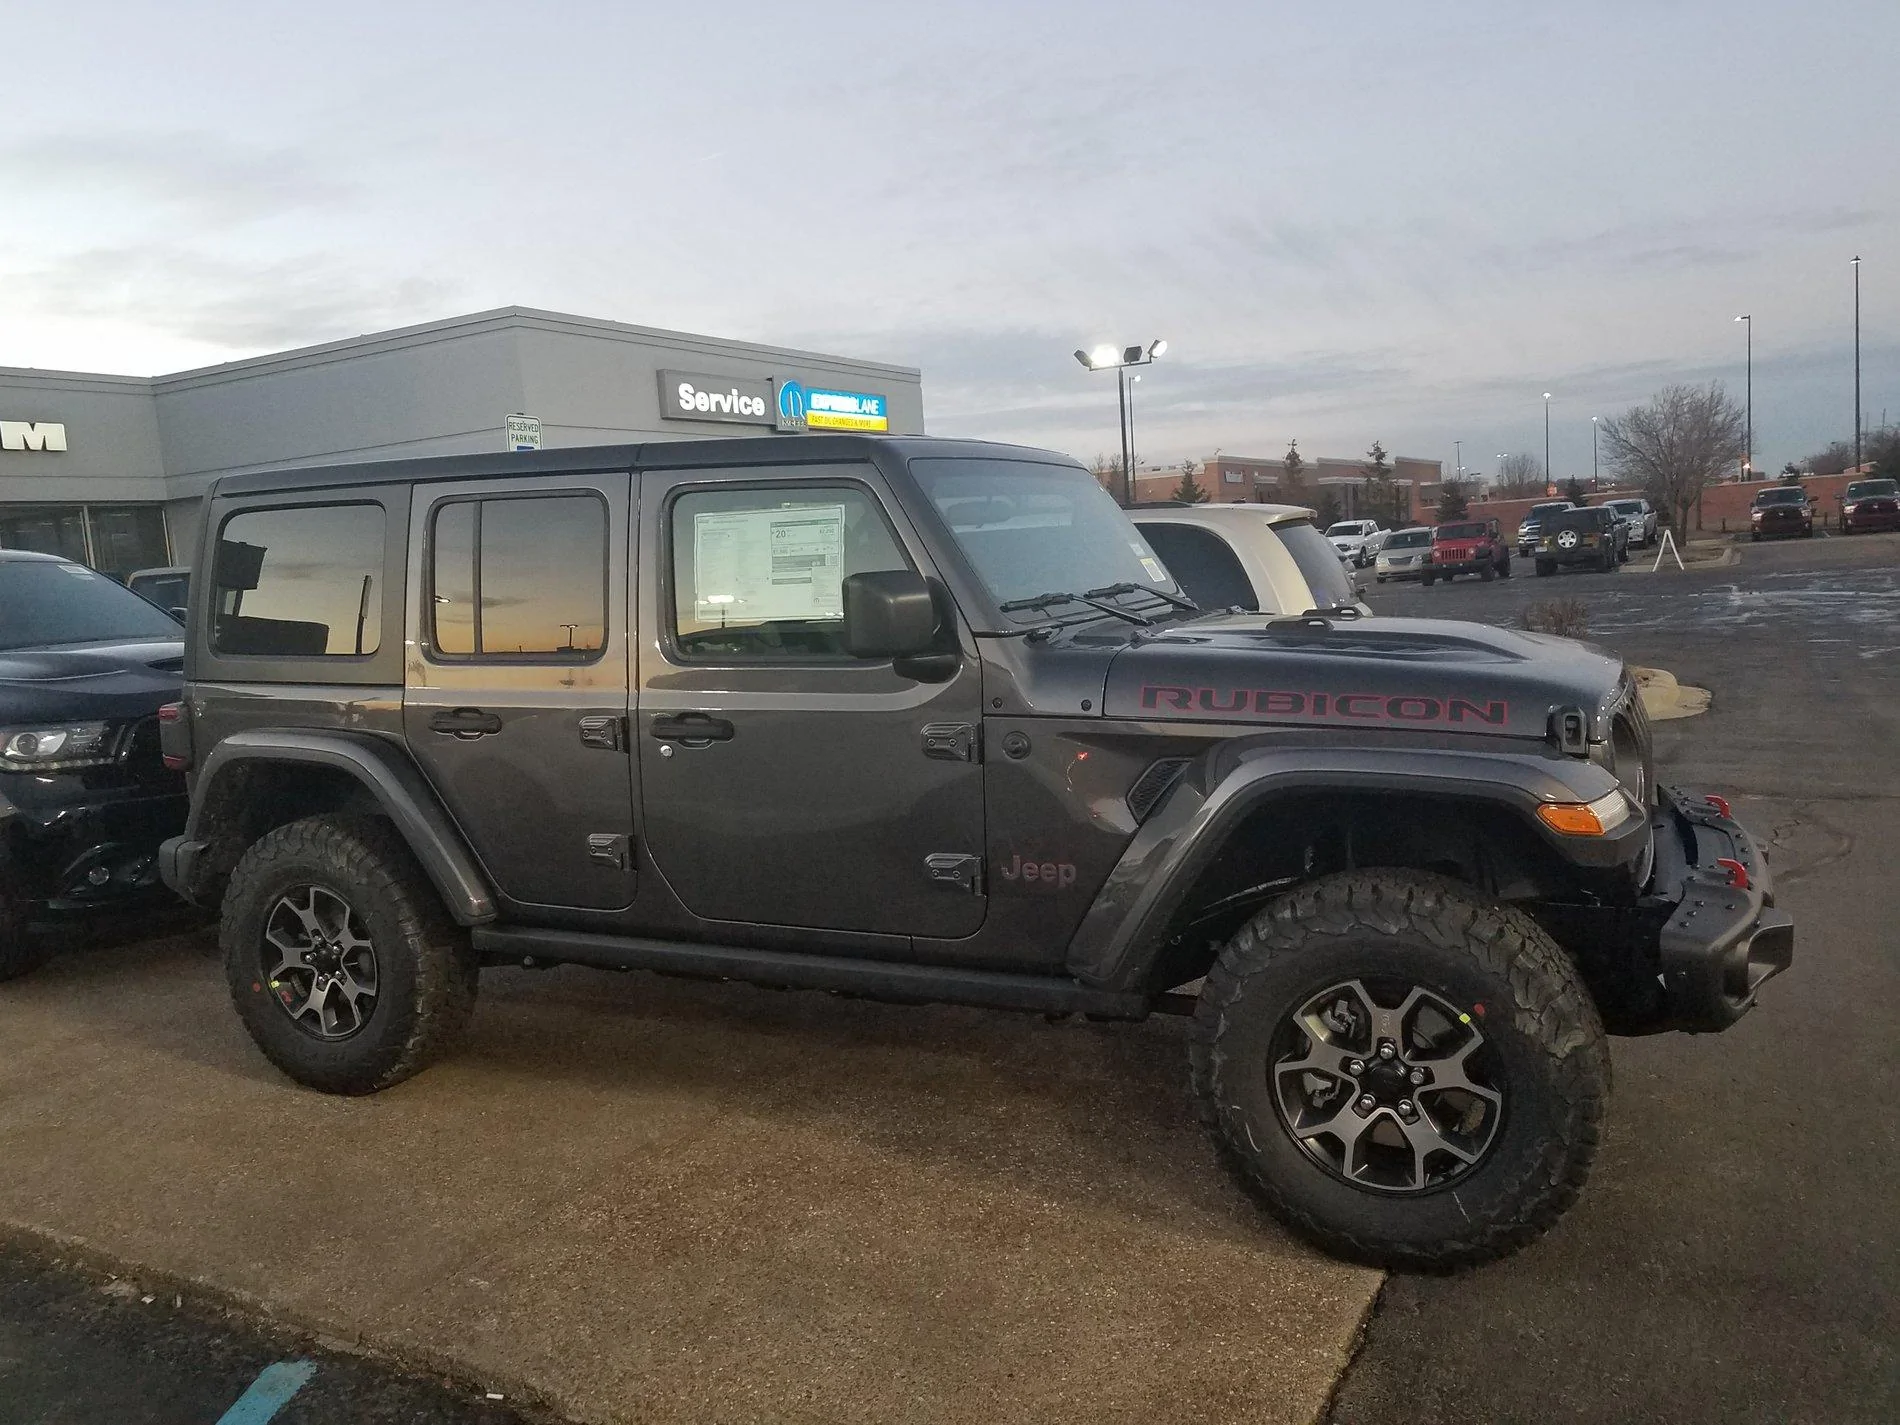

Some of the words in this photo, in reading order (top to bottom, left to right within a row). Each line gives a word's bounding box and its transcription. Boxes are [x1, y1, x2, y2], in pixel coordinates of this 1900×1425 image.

[678, 382, 766, 417] Service
[508, 421, 539, 433] RESERVED
[511, 433, 539, 445] PARKING
[775, 529, 786, 539] 20
[1140, 685, 1509, 726] RUBICON
[1001, 855, 1076, 888] Jeep
